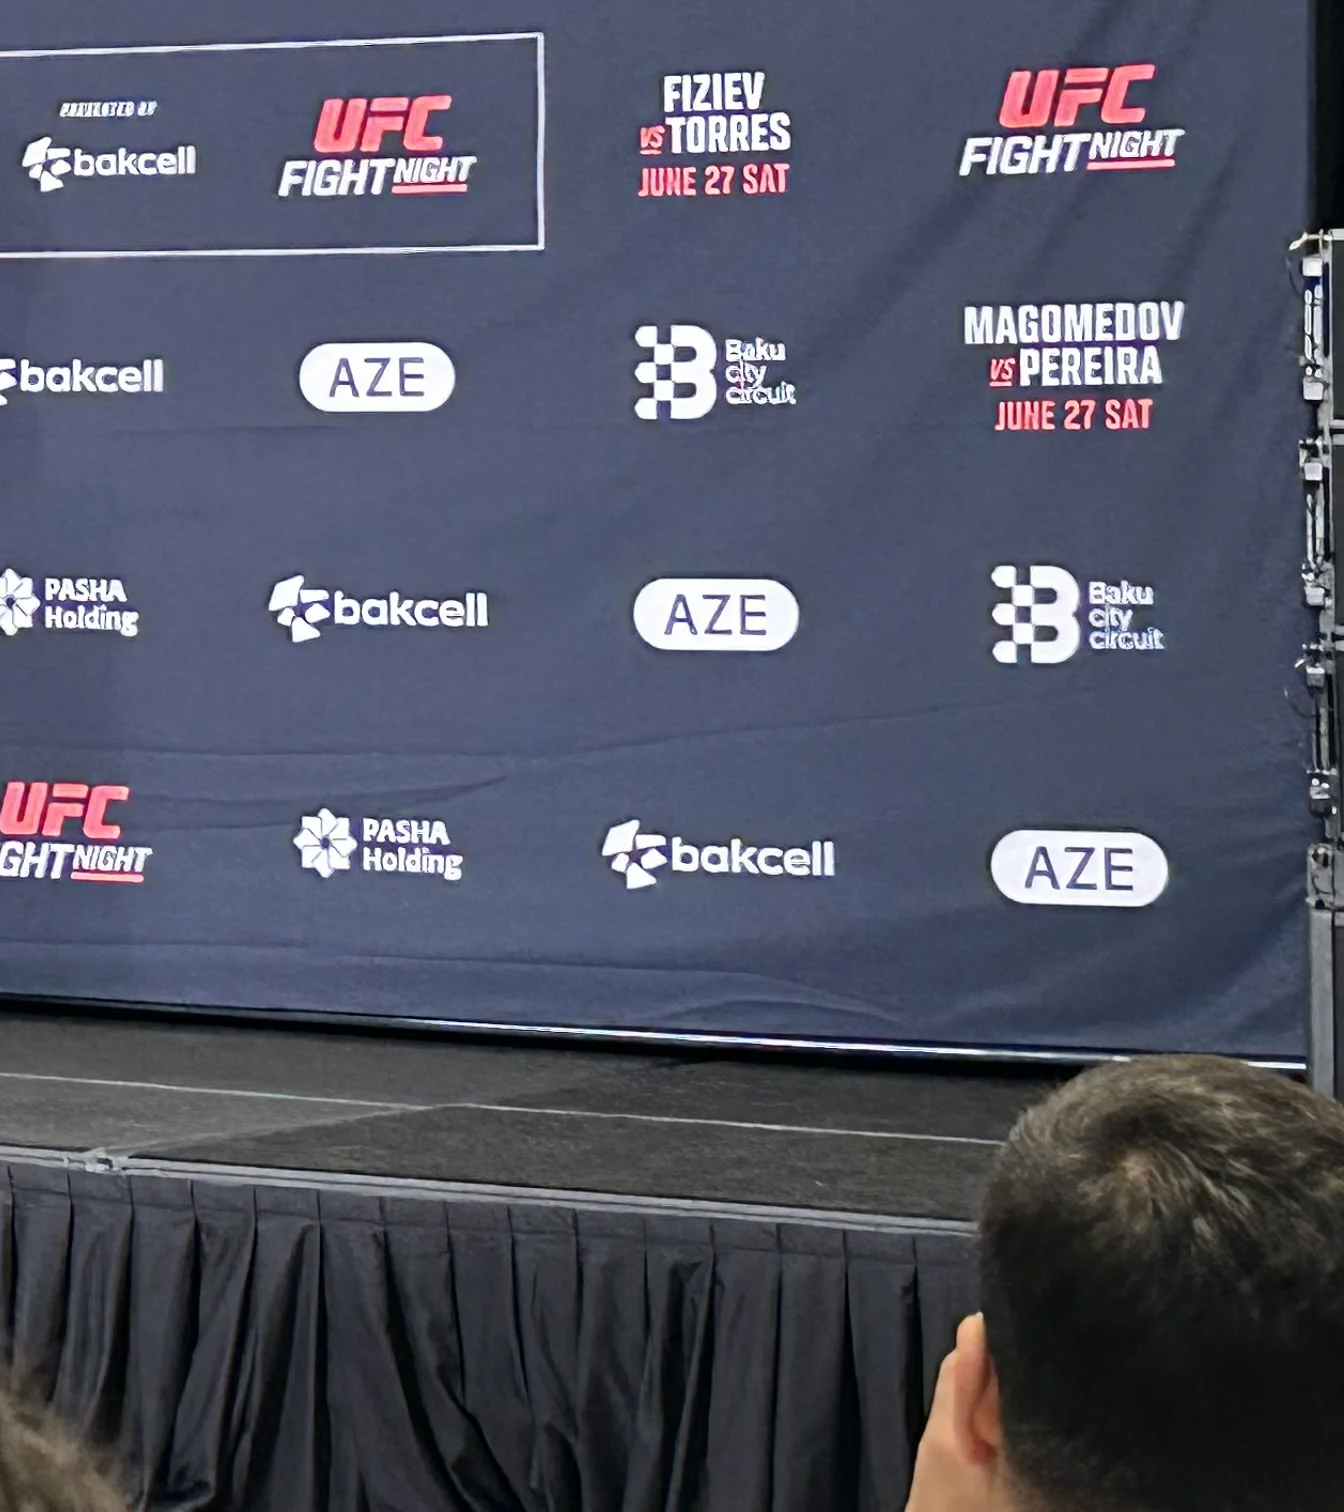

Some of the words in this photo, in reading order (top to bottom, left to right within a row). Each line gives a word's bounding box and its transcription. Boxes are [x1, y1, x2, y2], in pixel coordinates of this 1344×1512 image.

[664, 71, 766, 114] FIZIEV
[999, 64, 1156, 129] UFC
[314, 94, 452, 153] UFC
[665, 113, 791, 154] TORRES
[74, 145, 196, 176] bakcell
[960, 133, 1091, 177] FIGHT
[1088, 129, 1185, 160] NIGHT
[278, 158, 394, 196] FIGHT
[393, 155, 476, 183] NIGHT
[637, 167, 696, 197] JUNE
[705, 166, 736, 196] 27
[743, 163, 790, 195] SAT
[964, 300, 1185, 345] MAGOMEDOV
[725, 337, 786, 362] Baku
[991, 359, 1016, 382] VS
[1019, 346, 1162, 387] PEREIRA
[20, 359, 164, 394] bakcell
[329, 357, 425, 398] AZE
[995, 400, 1055, 431] JUNE
[1063, 399, 1097, 431] 27
[1104, 399, 1154, 431] SAT
[45, 578, 127, 603] PASHA
[1088, 580, 1154, 605] Baku
[45, 605, 139, 637] Holding
[335, 592, 489, 628] bakcell
[663, 593, 767, 636] AZE
[363, 817, 450, 846] PASHA
[72, 845, 153, 873] NIGHT
[363, 847, 463, 880] Holding
[672, 837, 835, 878] bakcell
[1024, 846, 1135, 892] AZE
